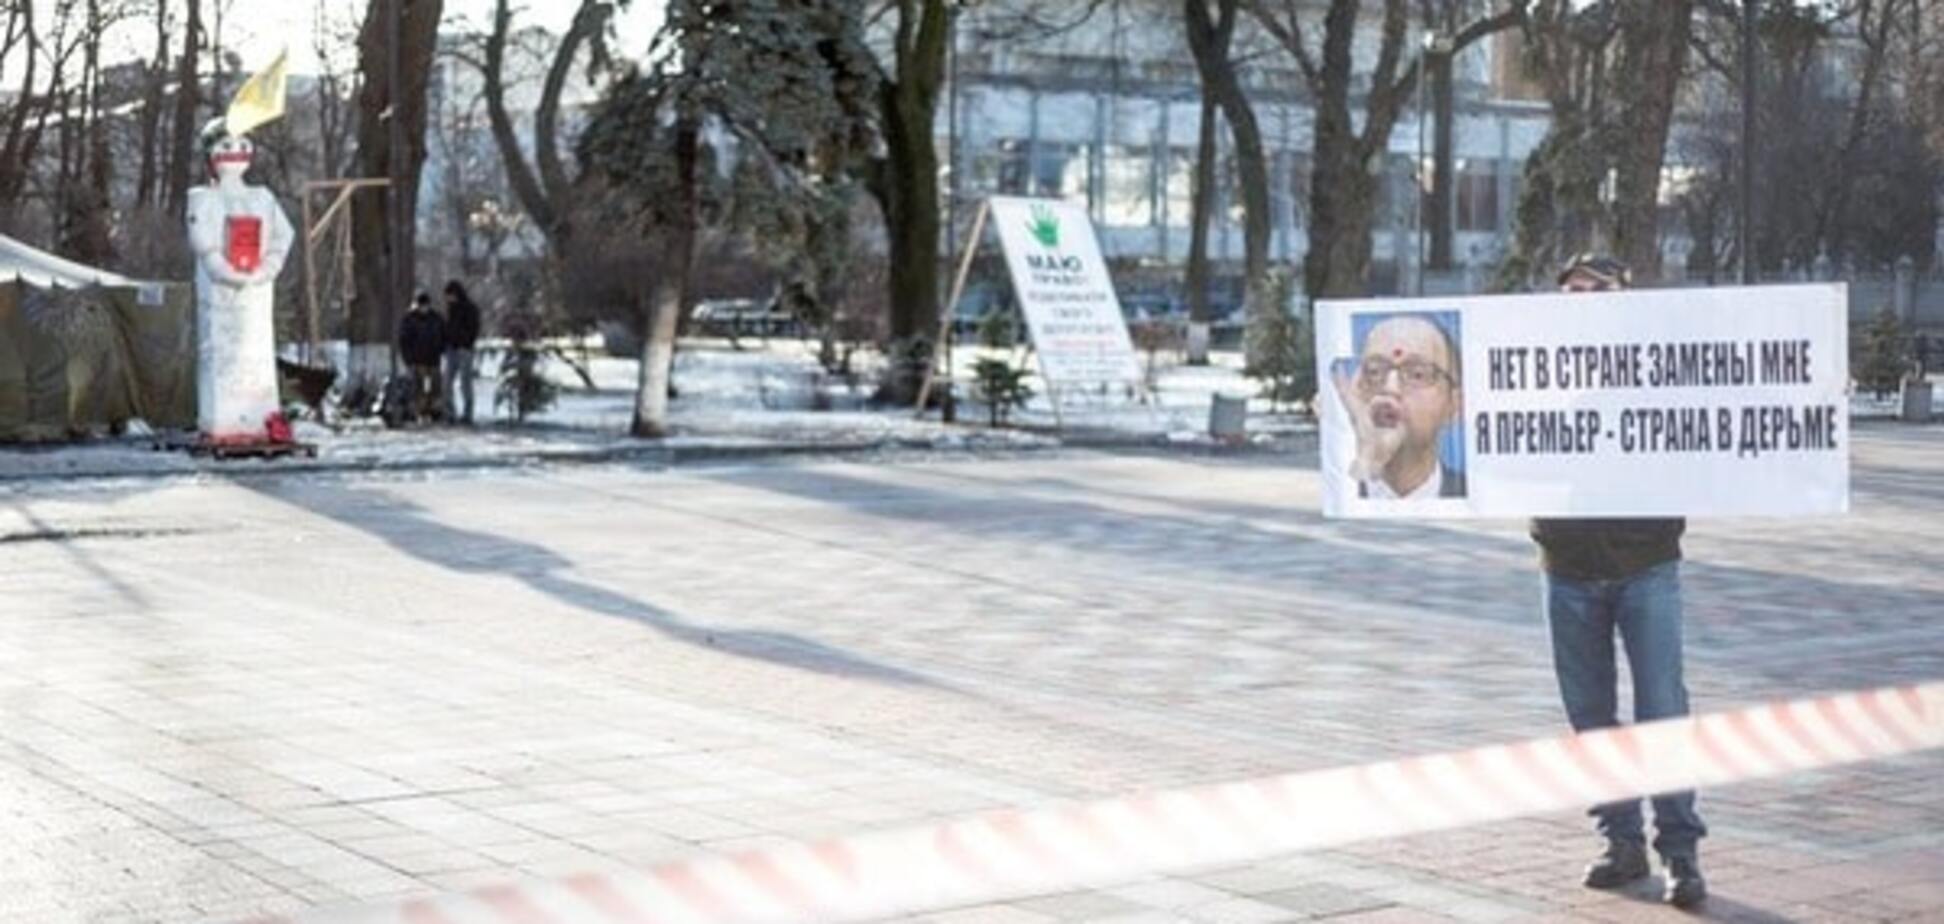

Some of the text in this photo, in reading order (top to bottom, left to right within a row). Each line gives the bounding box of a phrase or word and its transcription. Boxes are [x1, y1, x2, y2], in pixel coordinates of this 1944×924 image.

[1025, 255, 1083, 272] МАЮ
[1488, 340, 1812, 390] НЕТ В СТРАНЕ ЗАМЕНЫ МНЕ
[1476, 411, 1491, 454] Я
[1496, 409, 1600, 454] ПРЕМЬЕР
[1620, 407, 1712, 452] СТРАНА
[1717, 407, 1732, 451] В
[1737, 405, 1838, 458] ДЕРЬМЕ
